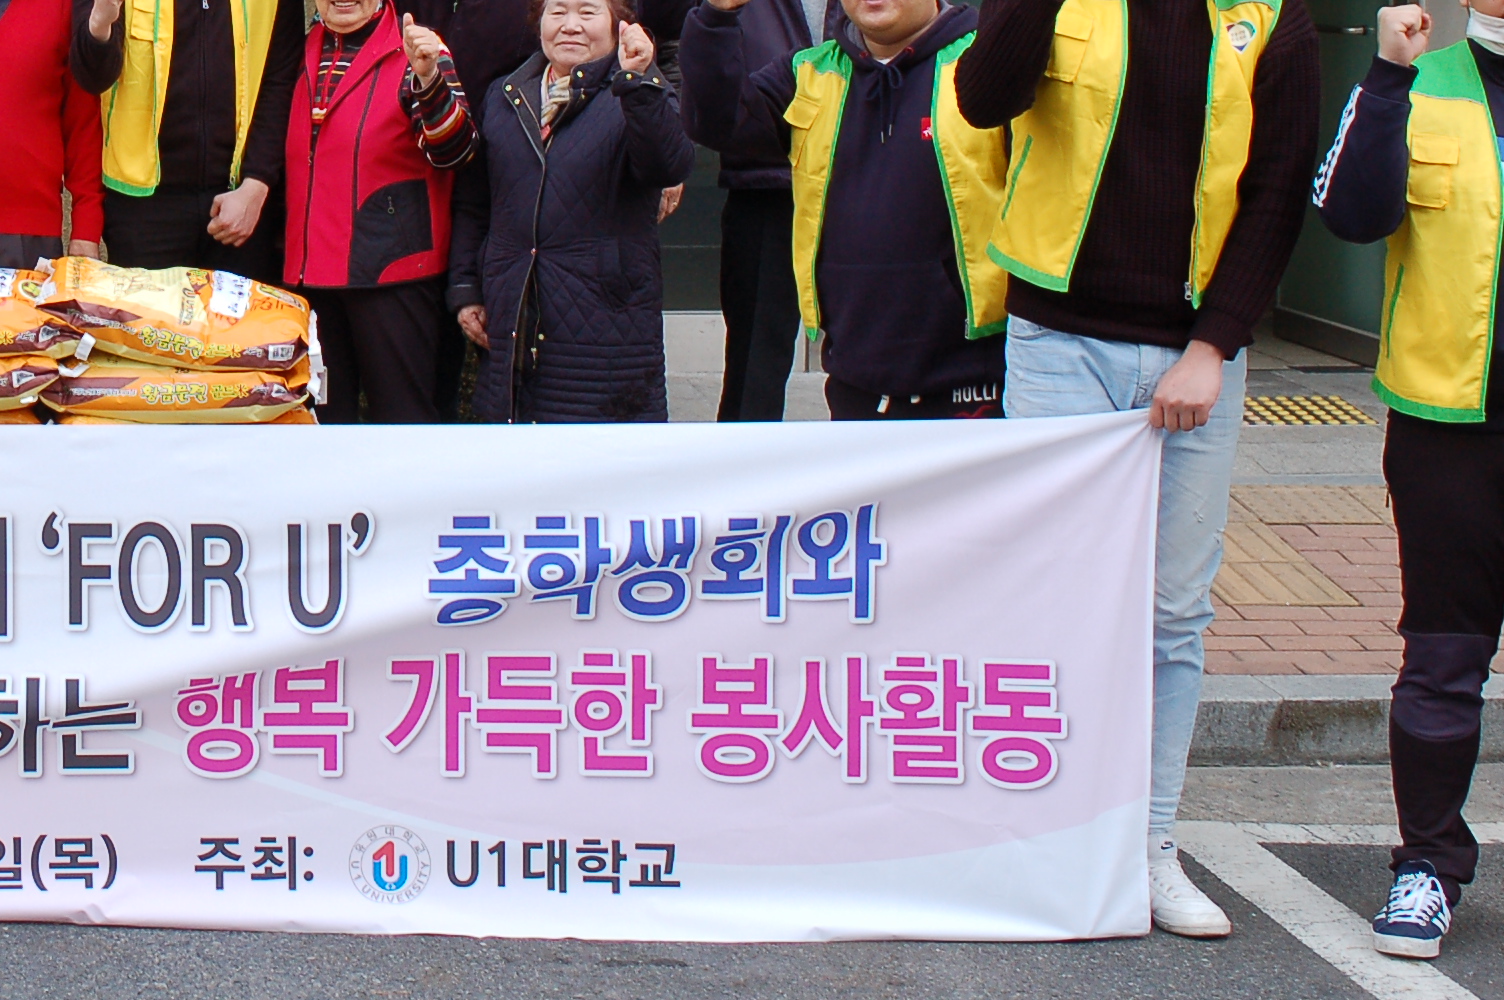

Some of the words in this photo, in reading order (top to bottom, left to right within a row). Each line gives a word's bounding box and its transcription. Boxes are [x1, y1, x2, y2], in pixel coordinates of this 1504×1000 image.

[427, 503, 882, 625] 총학생회와
[176, 658, 349, 774] 행복
[383, 652, 658, 773] 가득한
[690, 655, 1063, 785] 봉사활동
[194, 835, 315, 890] 주최:
[446, 837, 682, 895] U1대학교
[361, 861, 430, 904] UNIVERSITY
